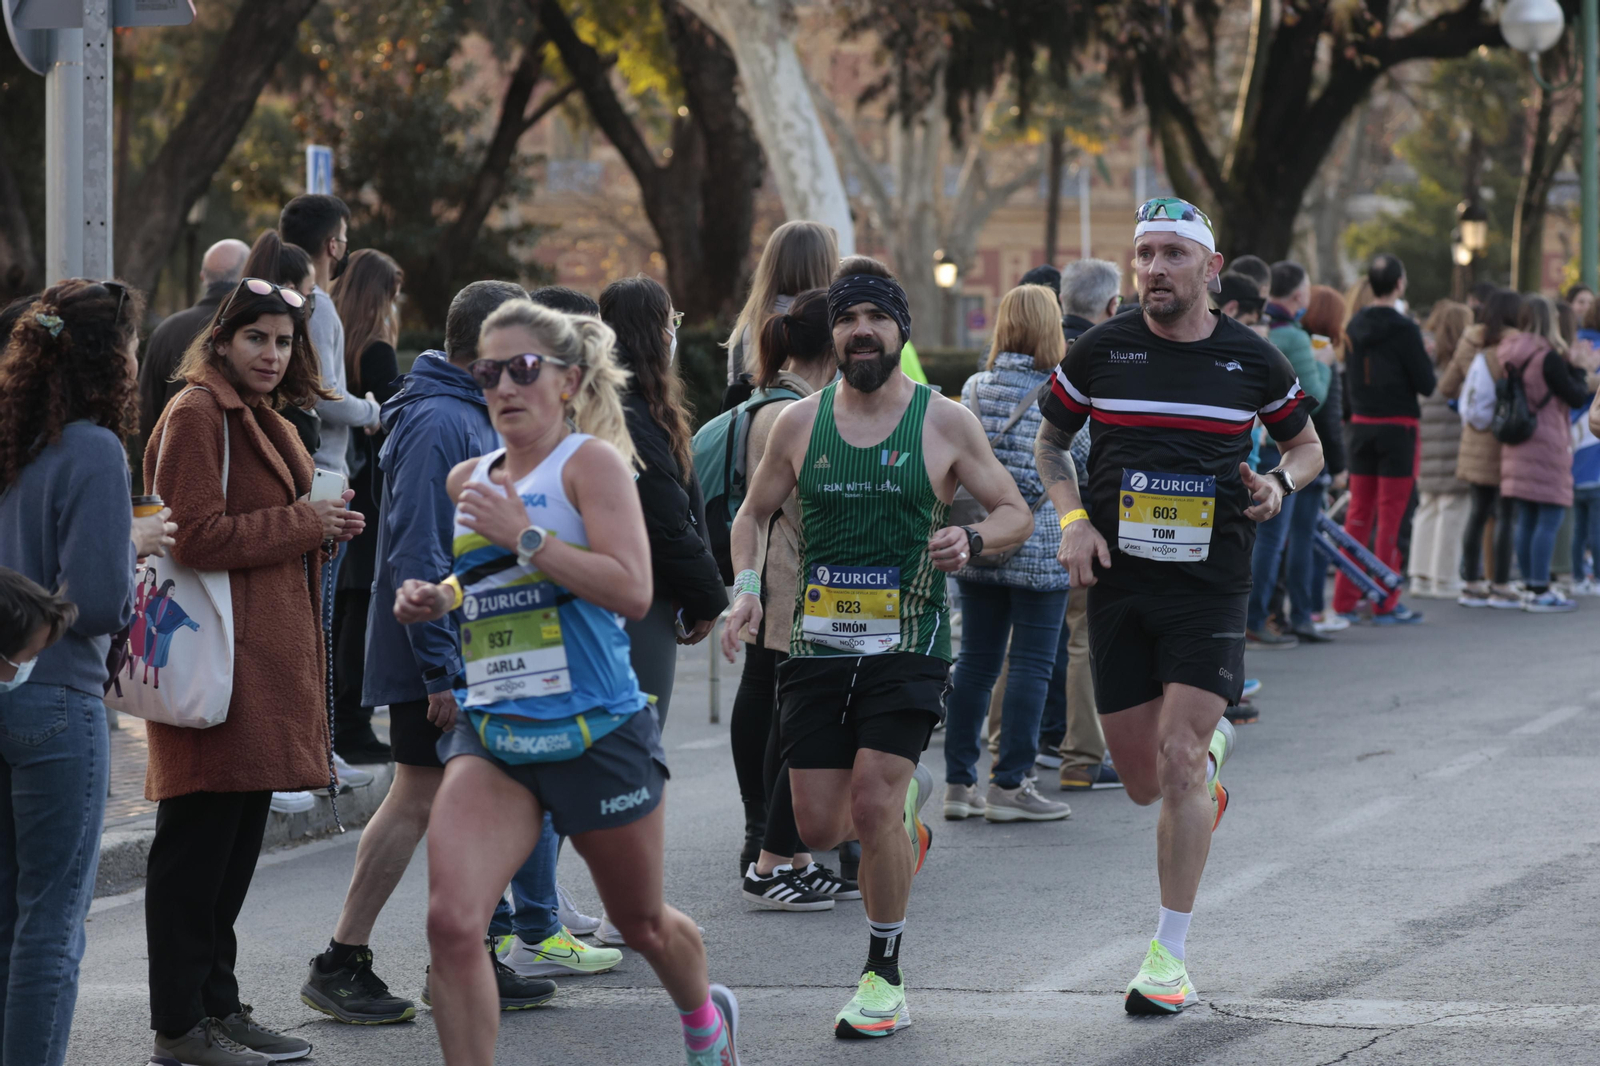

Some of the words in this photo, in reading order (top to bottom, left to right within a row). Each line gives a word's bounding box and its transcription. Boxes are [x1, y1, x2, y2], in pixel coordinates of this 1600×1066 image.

[1110, 351, 1148, 360] kiwami
[817, 484, 820, 493] I
[823, 482, 843, 493] RUN
[846, 481, 872, 492] WITH
[1150, 478, 1204, 493] ZURICH
[1153, 506, 1178, 520] 603
[1152, 528, 1176, 540] TOM
[832, 572, 887, 585] ZURICH
[480, 589, 541, 613] ZURICH
[836, 600, 861, 614] 623
[832, 621, 867, 633] SIMÓN
[486, 657, 526, 676] CARLA
[495, 734, 549, 754] HOKA
[600, 786, 651, 815] HOKA
